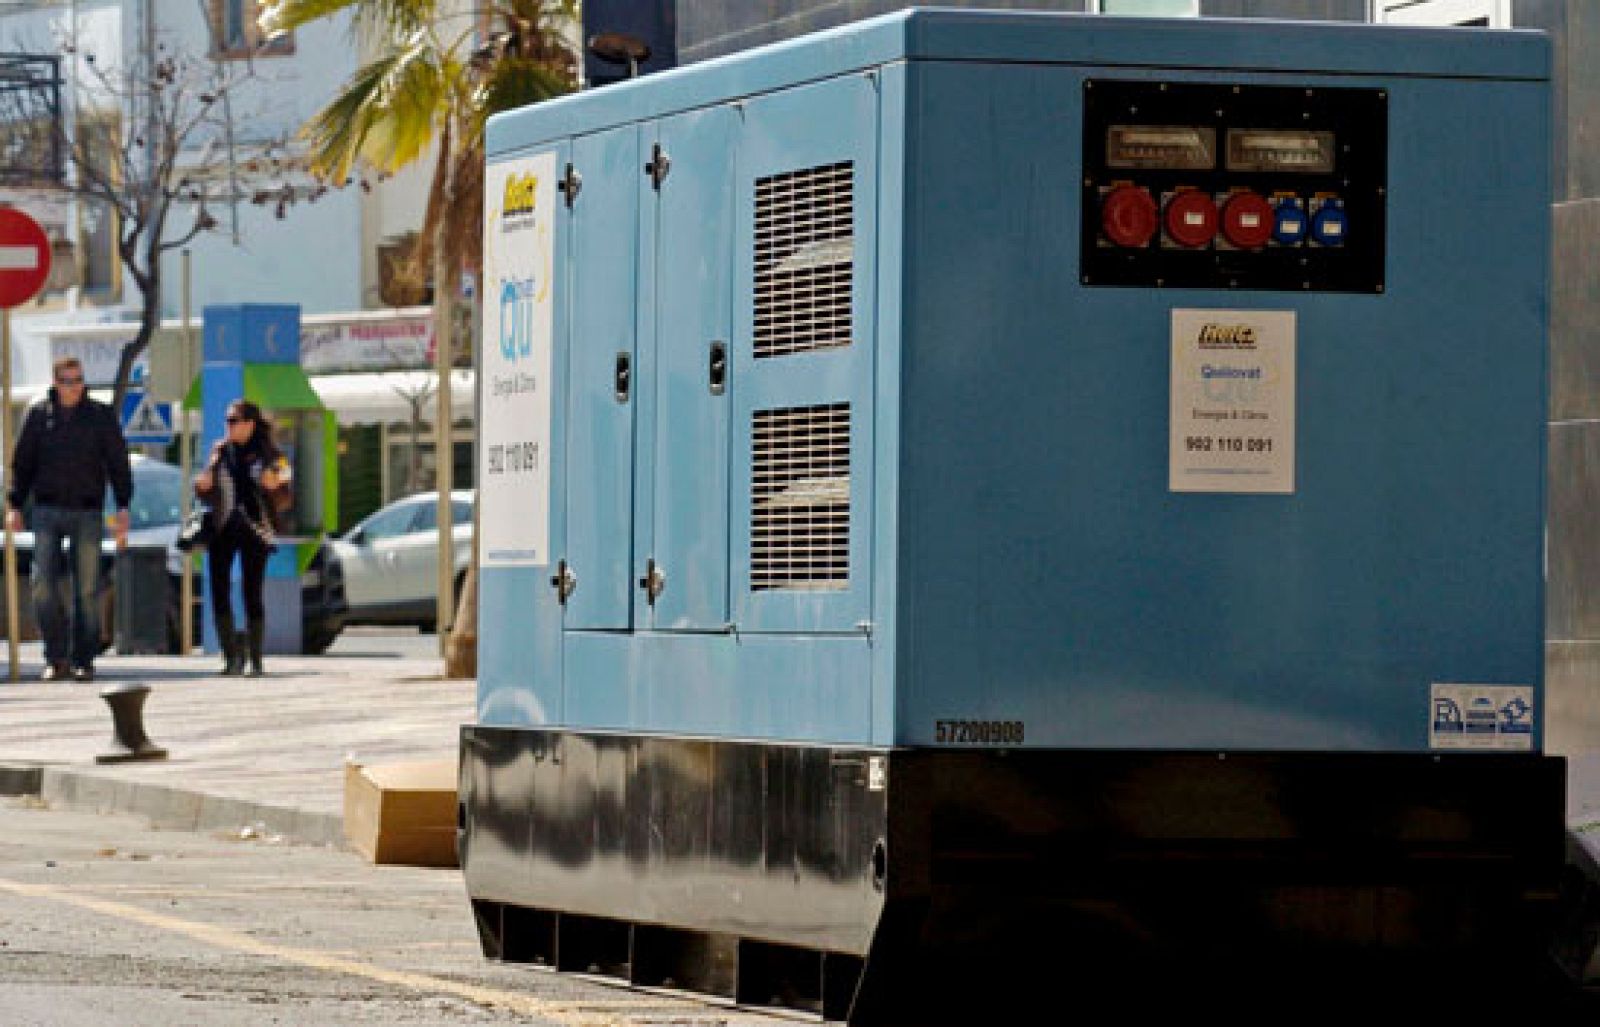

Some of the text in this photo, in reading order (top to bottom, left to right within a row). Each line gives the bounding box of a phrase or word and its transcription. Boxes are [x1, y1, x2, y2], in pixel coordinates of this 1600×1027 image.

[1186, 435, 1272, 452] 902 110 091
